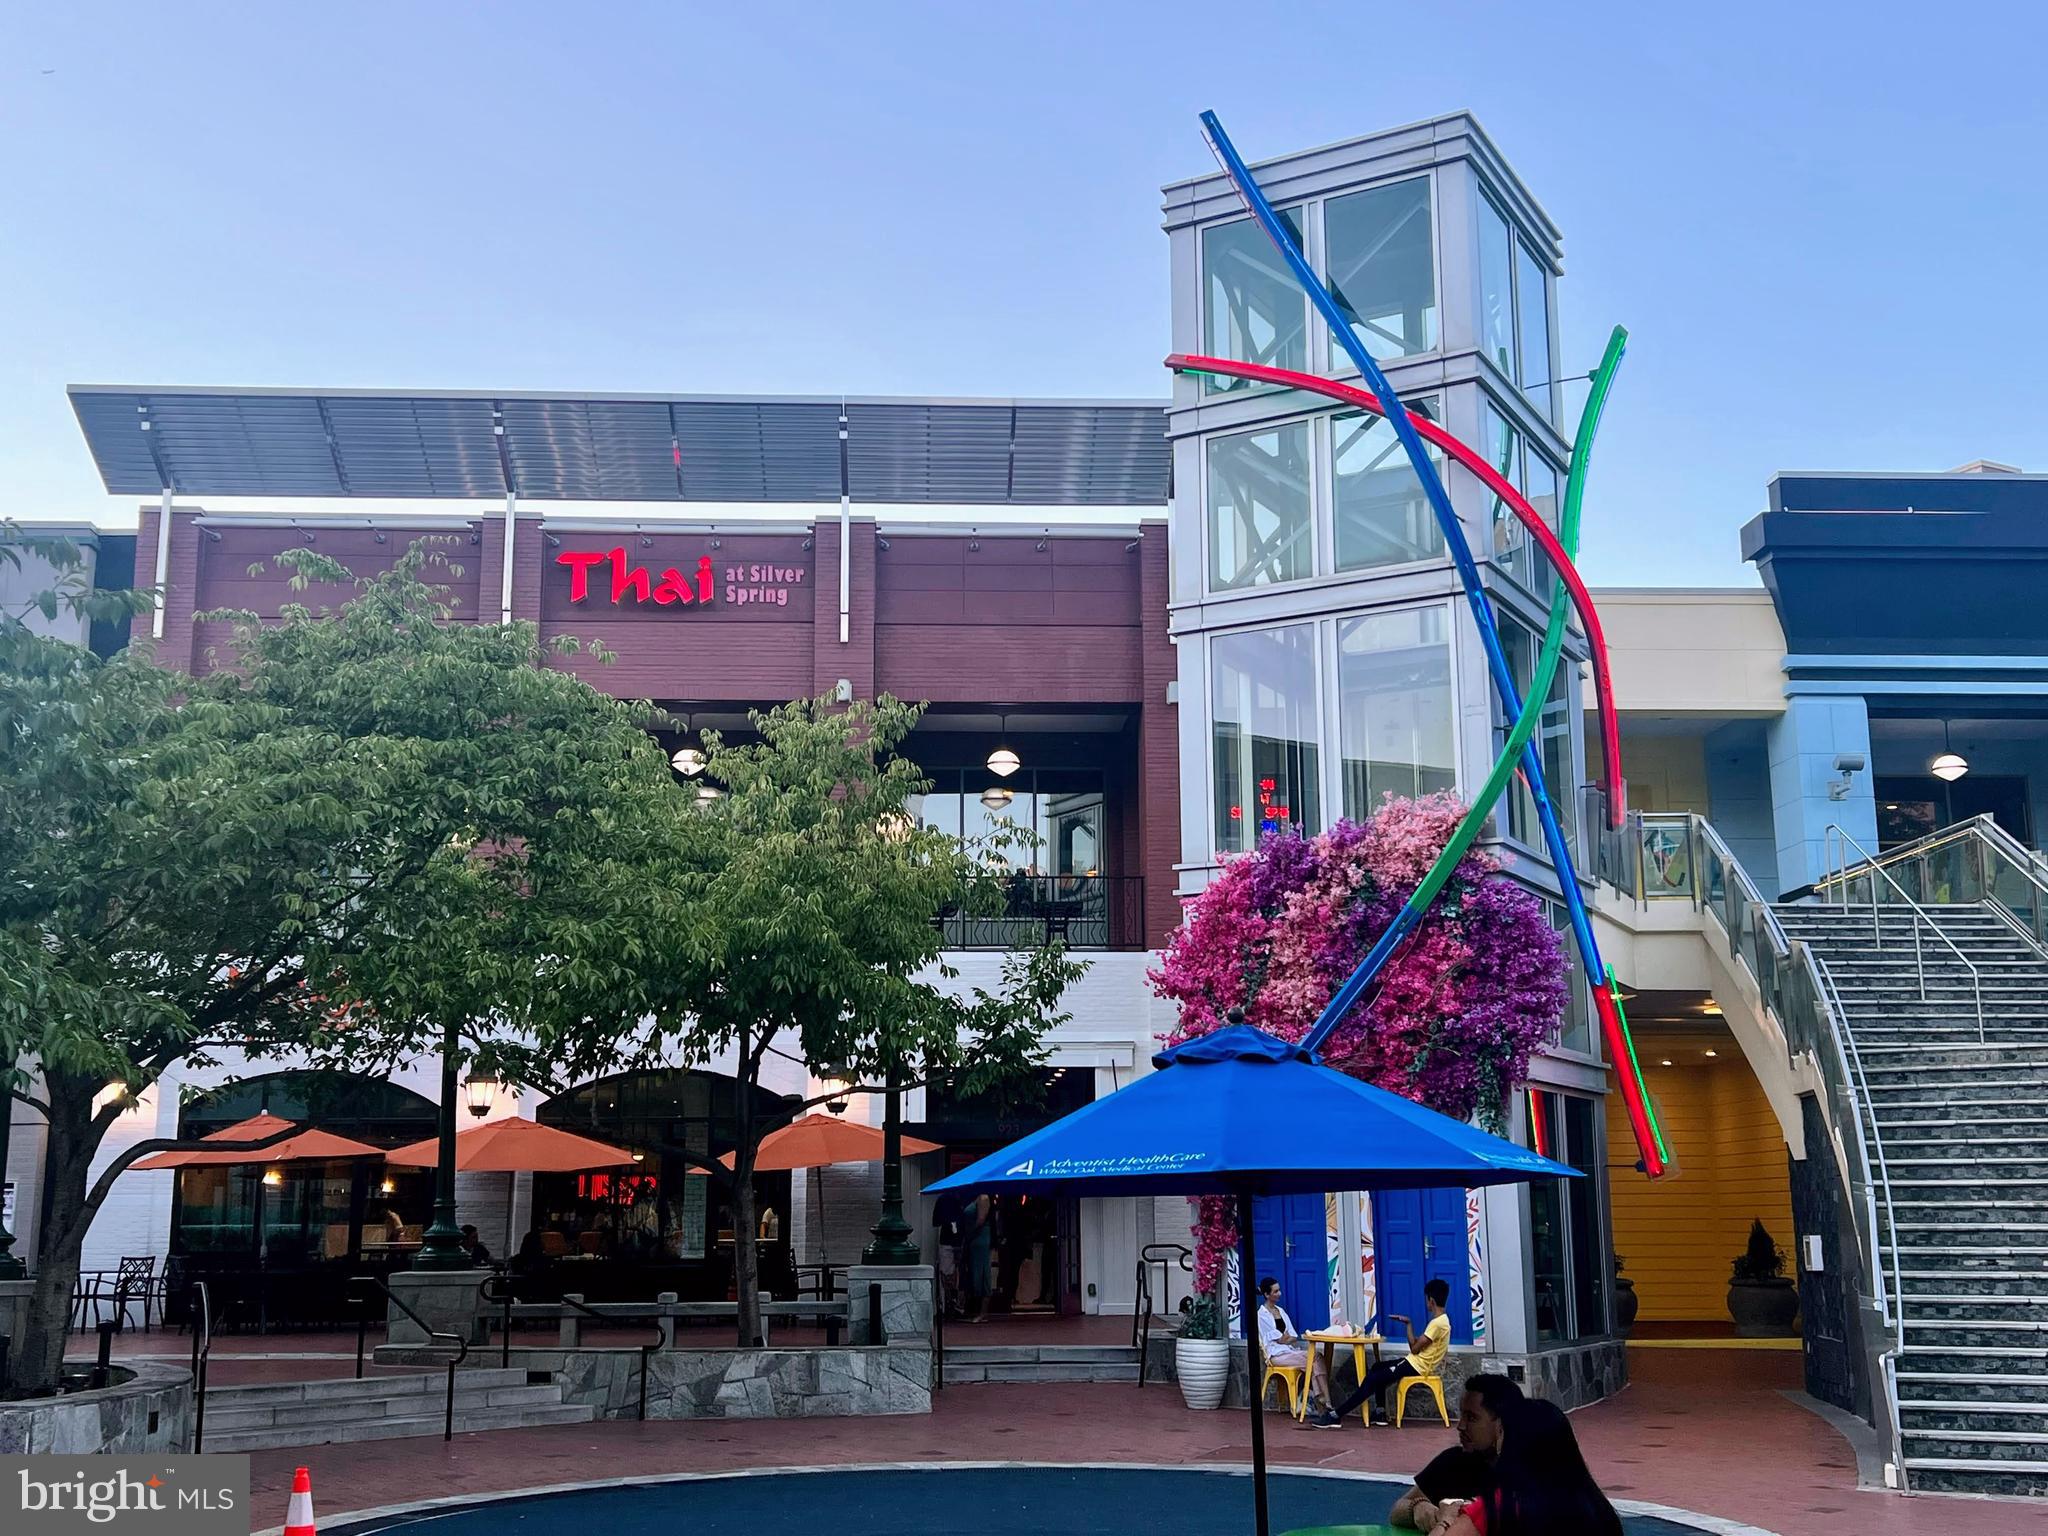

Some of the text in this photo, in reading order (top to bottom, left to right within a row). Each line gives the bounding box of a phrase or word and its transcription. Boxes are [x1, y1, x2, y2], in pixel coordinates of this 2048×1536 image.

[555, 547, 714, 607] Thai
[726, 565, 804, 583] at Silver
[726, 585, 788, 605] Spring
[1039, 1167, 1071, 1175] White
[1147, 1163, 1185, 1171] Center
[1044, 1152, 1206, 1168] Adventist HealthCare
